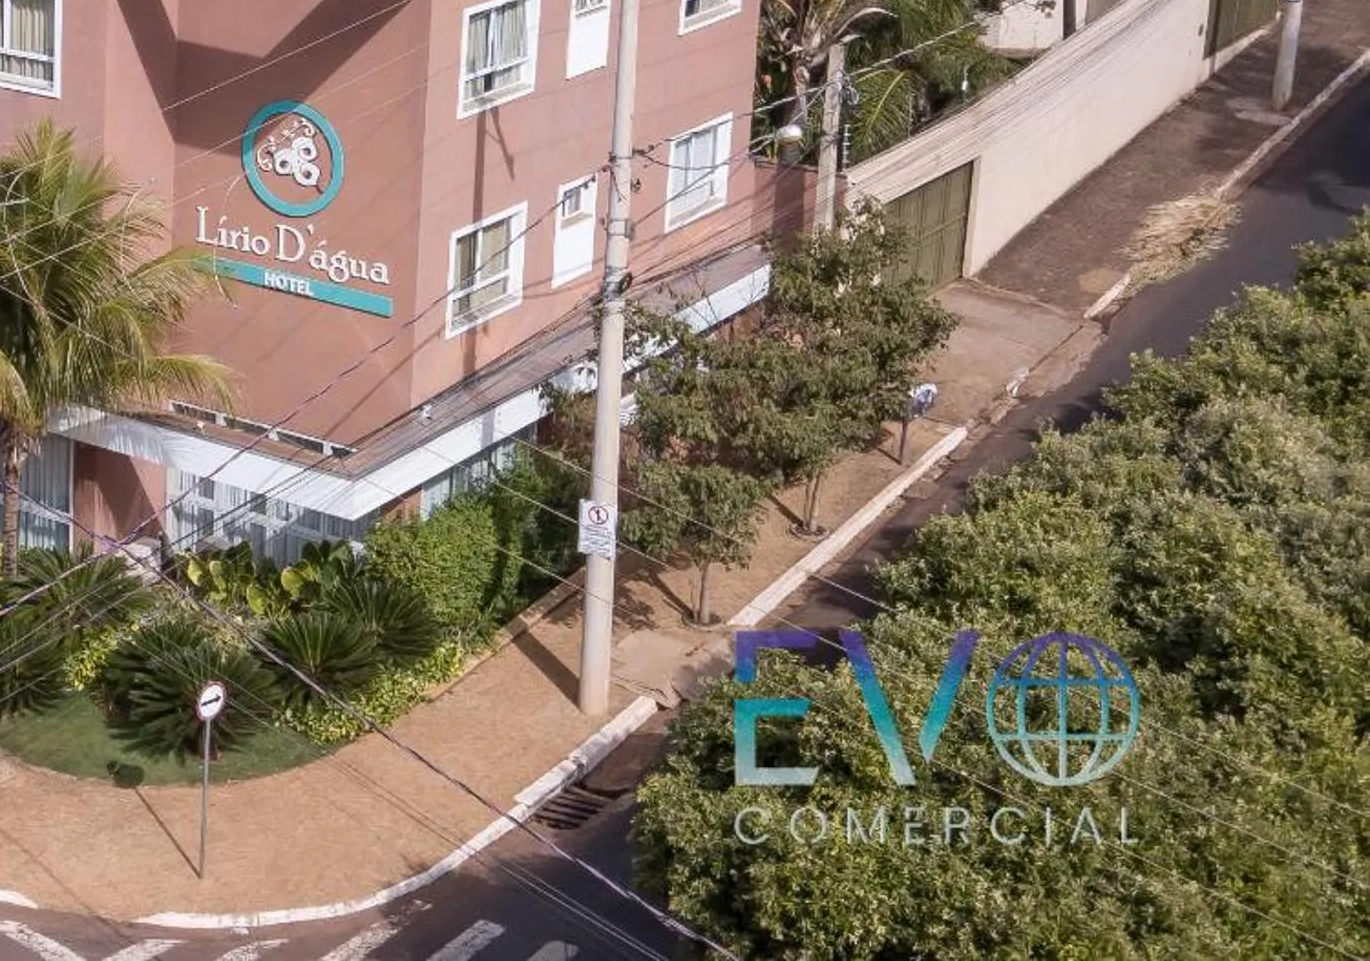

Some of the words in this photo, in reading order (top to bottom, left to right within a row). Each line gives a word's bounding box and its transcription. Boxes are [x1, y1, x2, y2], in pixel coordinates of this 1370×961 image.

[195, 206, 271, 255] Lírio
[275, 224, 390, 284] D'água
[263, 271, 315, 297] HOTEL
